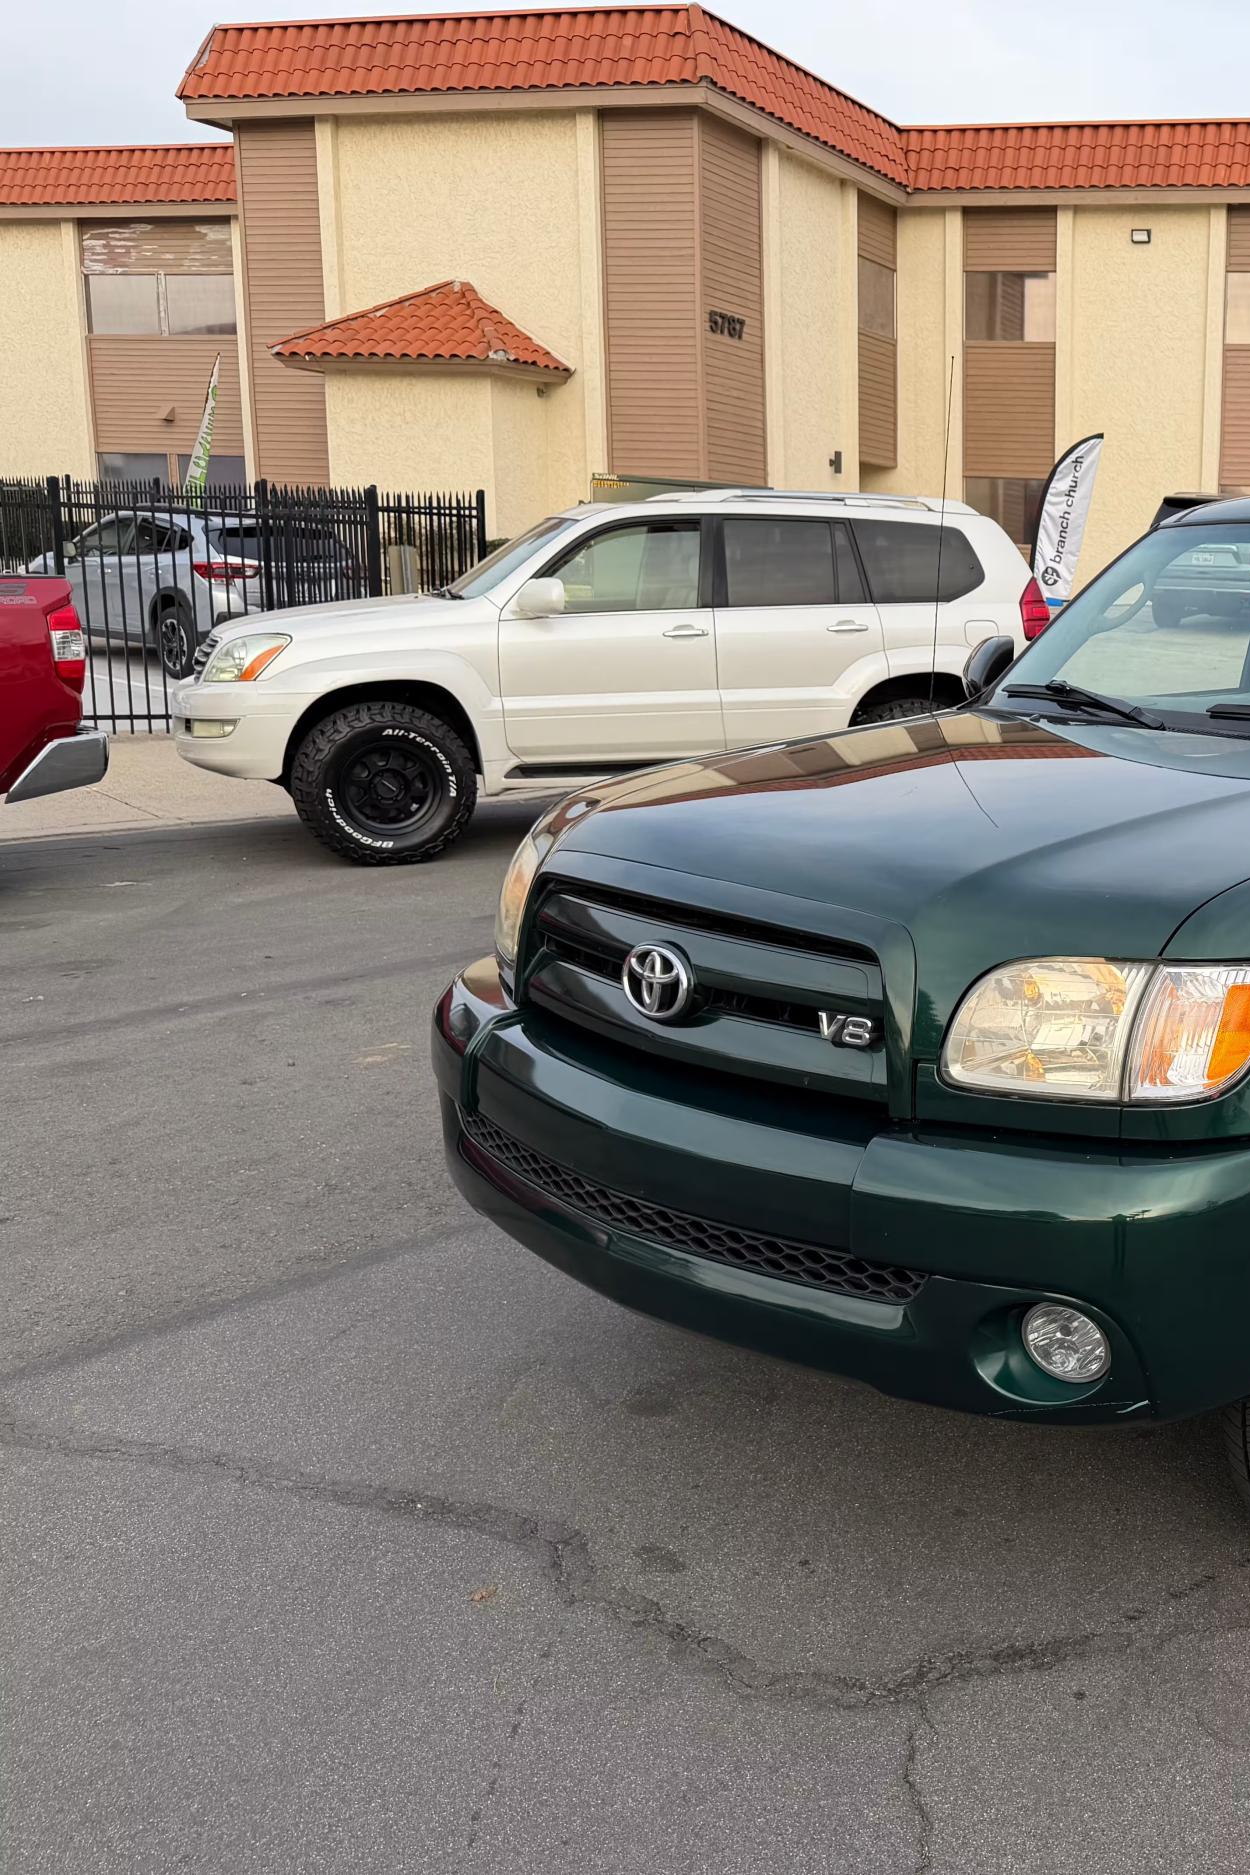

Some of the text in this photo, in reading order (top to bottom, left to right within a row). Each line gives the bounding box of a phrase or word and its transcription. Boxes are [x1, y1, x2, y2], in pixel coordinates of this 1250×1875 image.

[709, 309, 746, 340] 5787
[1050, 455, 1084, 564] branch church
[382, 728, 458, 797] All-Terrain T/A
[325, 788, 394, 849] BFGoodrich
[818, 1011, 872, 1046] V8
